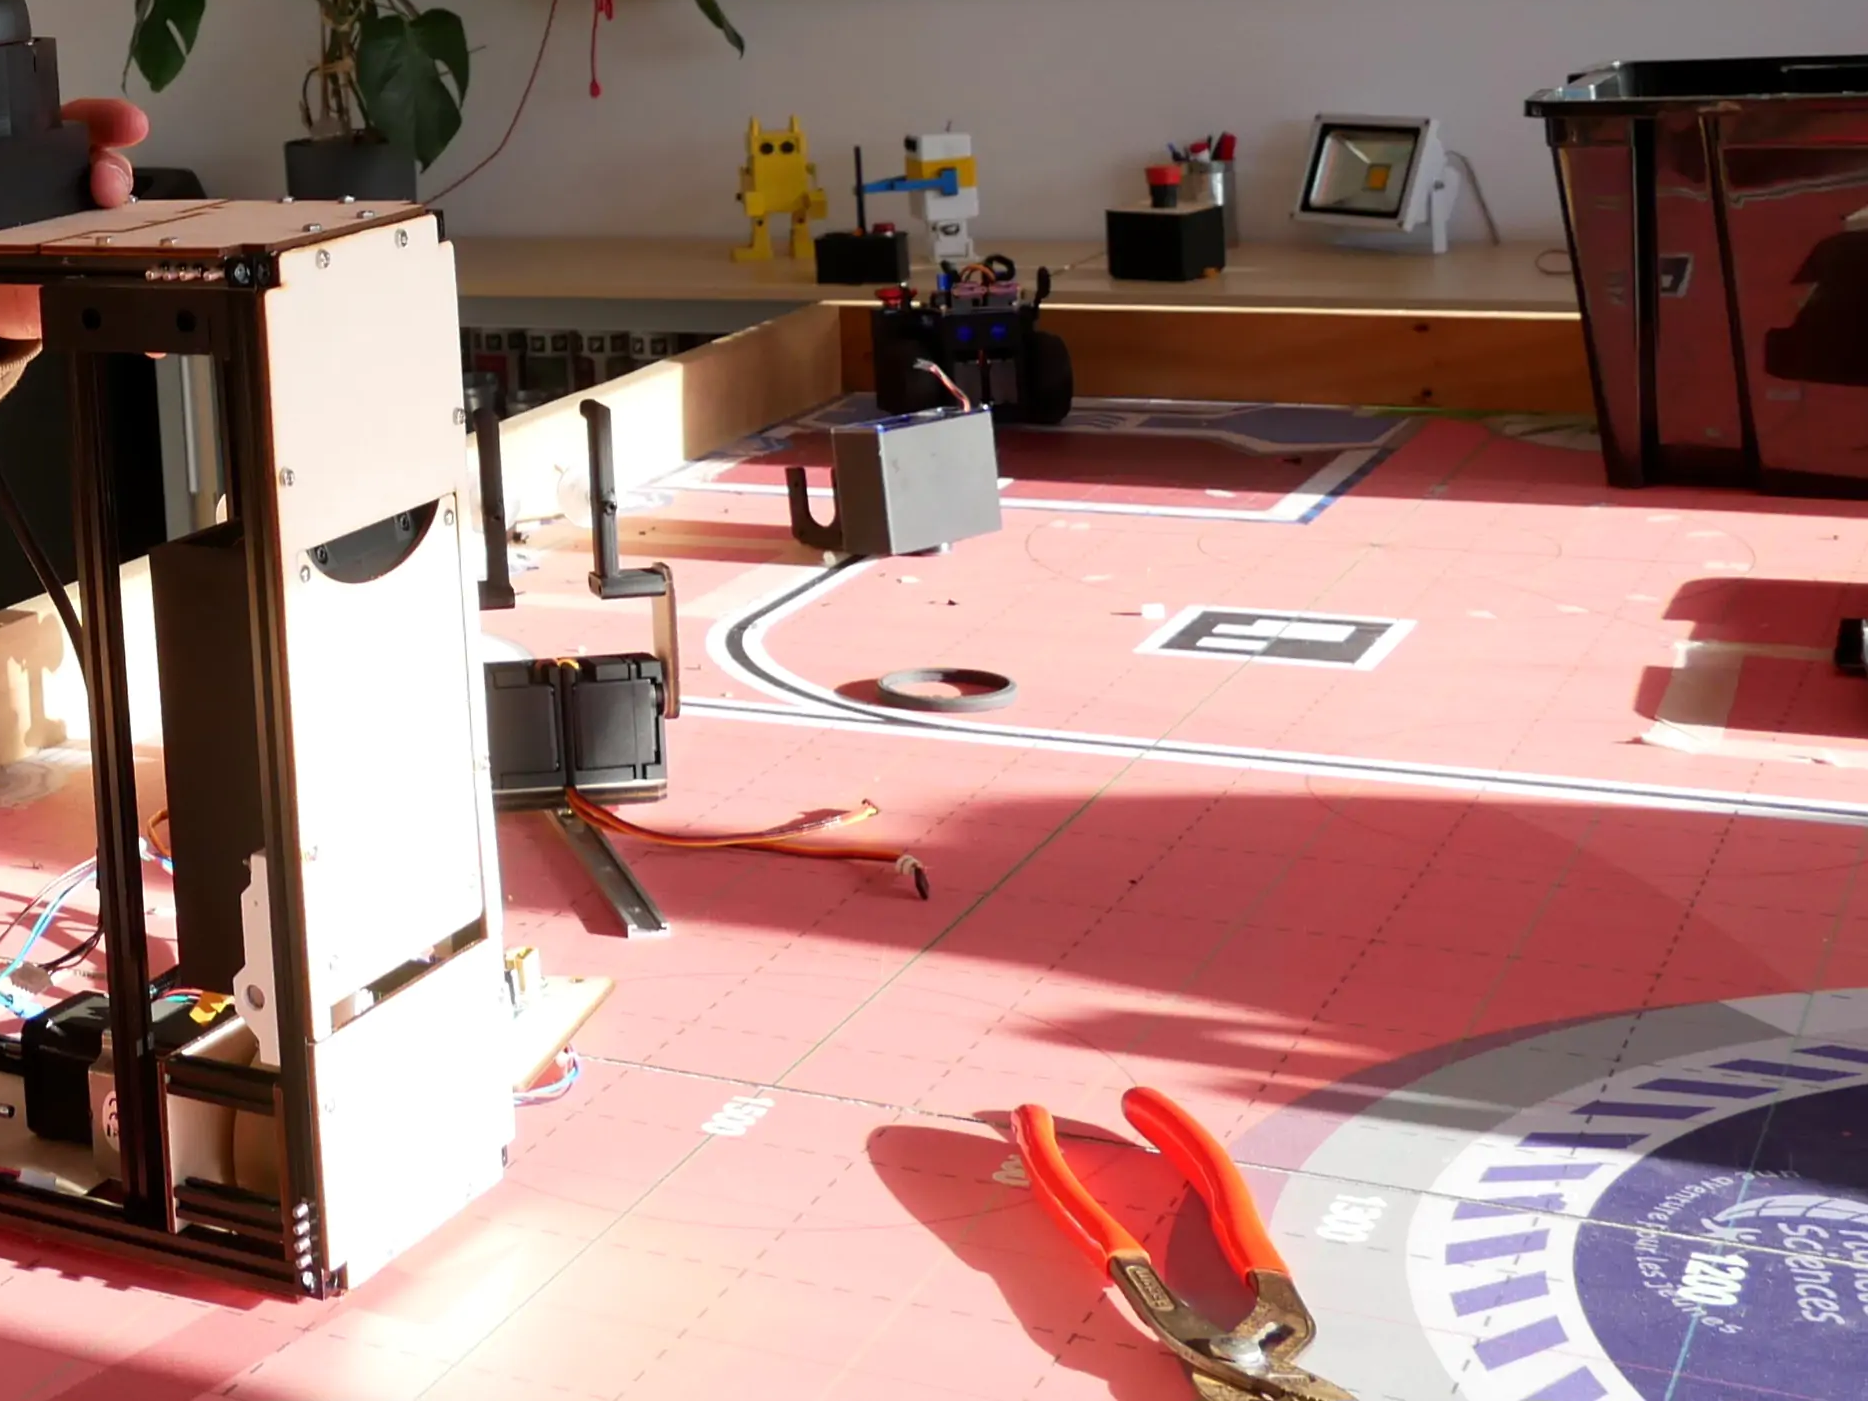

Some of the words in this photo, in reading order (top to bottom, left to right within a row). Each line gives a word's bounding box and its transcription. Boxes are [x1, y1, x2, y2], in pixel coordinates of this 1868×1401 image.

[701, 1095, 776, 1136] 1500
[1316, 1193, 1388, 1243] 1300
[1647, 1174, 1734, 1223] aventure
[1634, 1220, 1666, 1253] pour
[1635, 1256, 1669, 1279] les
[1677, 1251, 1750, 1306] 1200
[1778, 1222, 1846, 1326] Sciences
